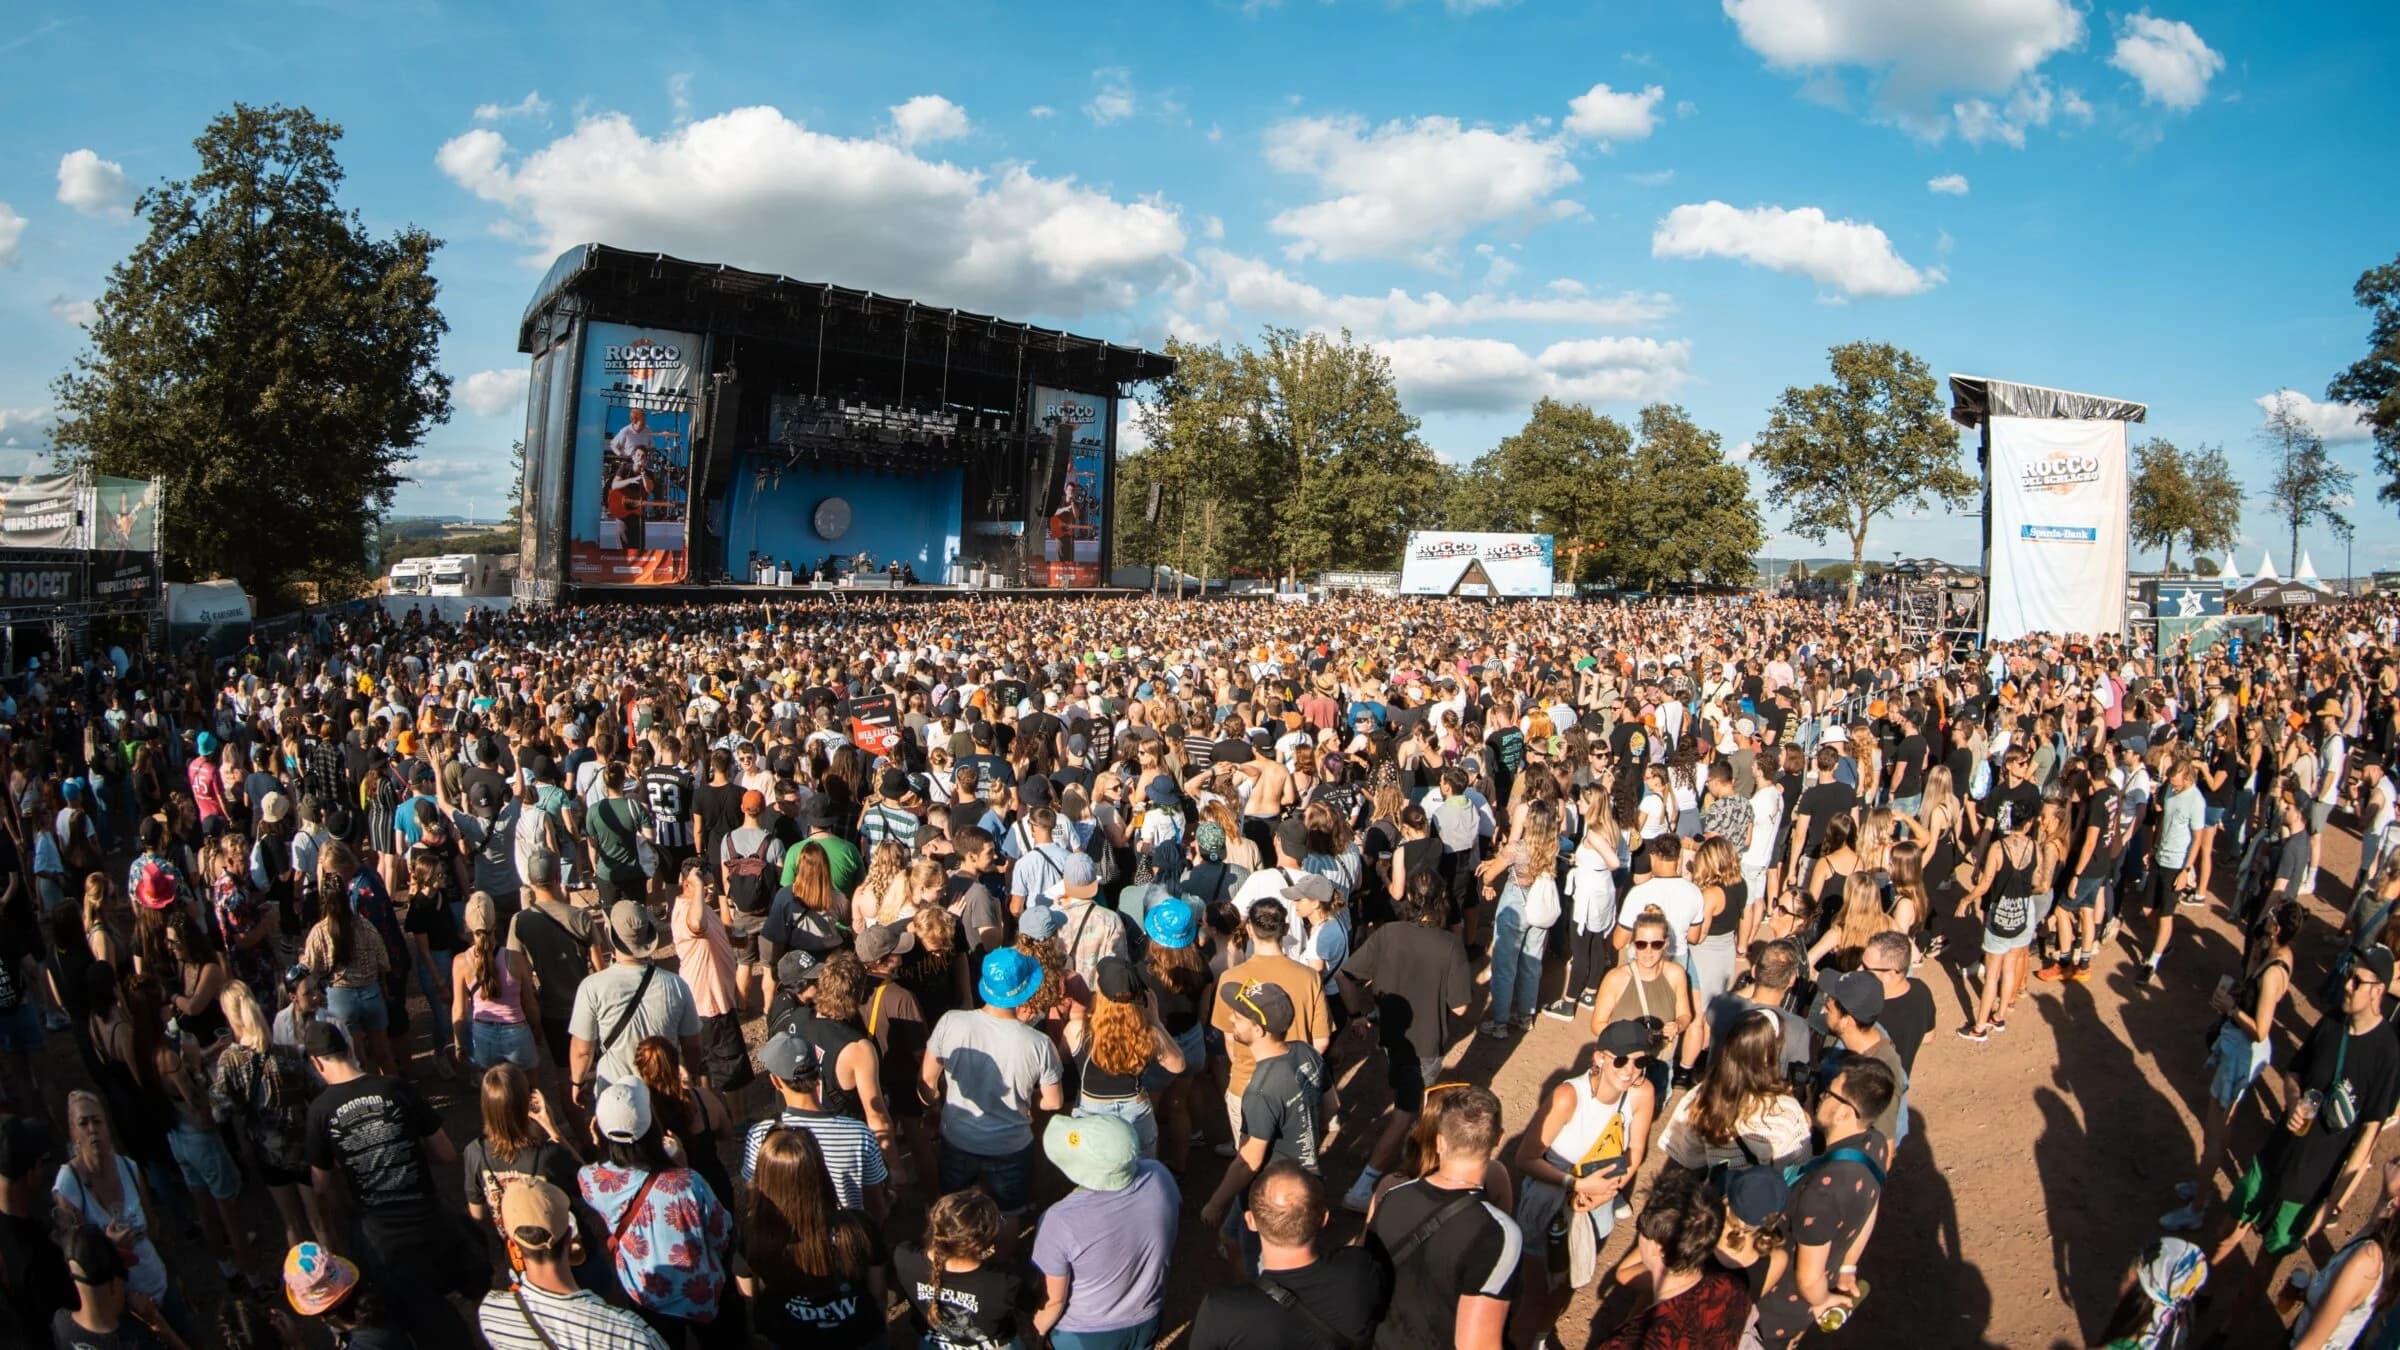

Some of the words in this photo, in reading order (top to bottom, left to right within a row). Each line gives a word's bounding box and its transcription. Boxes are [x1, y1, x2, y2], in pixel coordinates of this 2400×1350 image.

[604, 345, 680, 361] ROCCO
[604, 361, 625, 369] DEL
[626, 360, 680, 369] SCHLACKO
[1047, 404, 1094, 417] ROCCO
[2021, 456, 2098, 477] ROCCO
[2022, 476, 2042, 486] DEL
[2043, 472, 2098, 484] SCHLACKO
[4, 516, 37, 532] URPILS
[1416, 542, 1477, 553] ROCCO
[1486, 544, 1542, 554] ROCCO
[647, 782, 679, 815] 23
